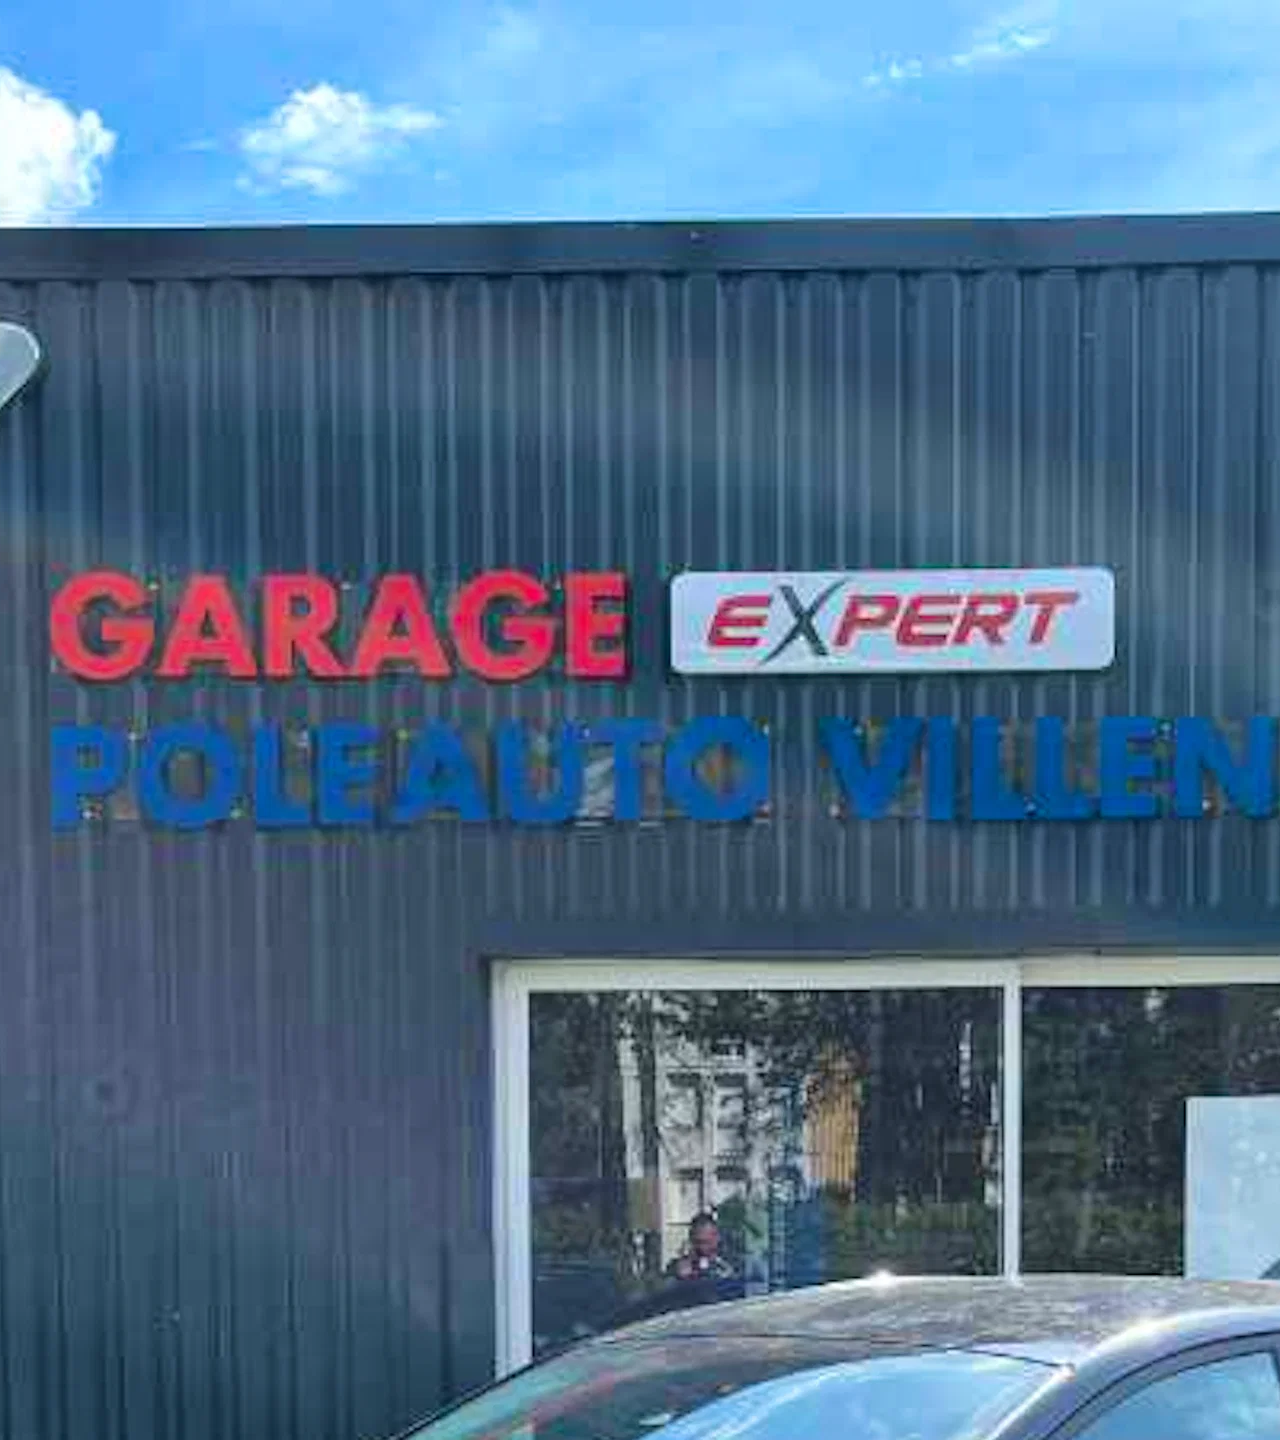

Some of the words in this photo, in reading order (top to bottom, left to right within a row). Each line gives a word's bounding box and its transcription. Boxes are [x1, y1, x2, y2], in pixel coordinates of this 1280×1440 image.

[49, 570, 629, 681] GARAGE
[707, 579, 1080, 666] EXPERT
[50, 715, 770, 828] POLEAUTO
